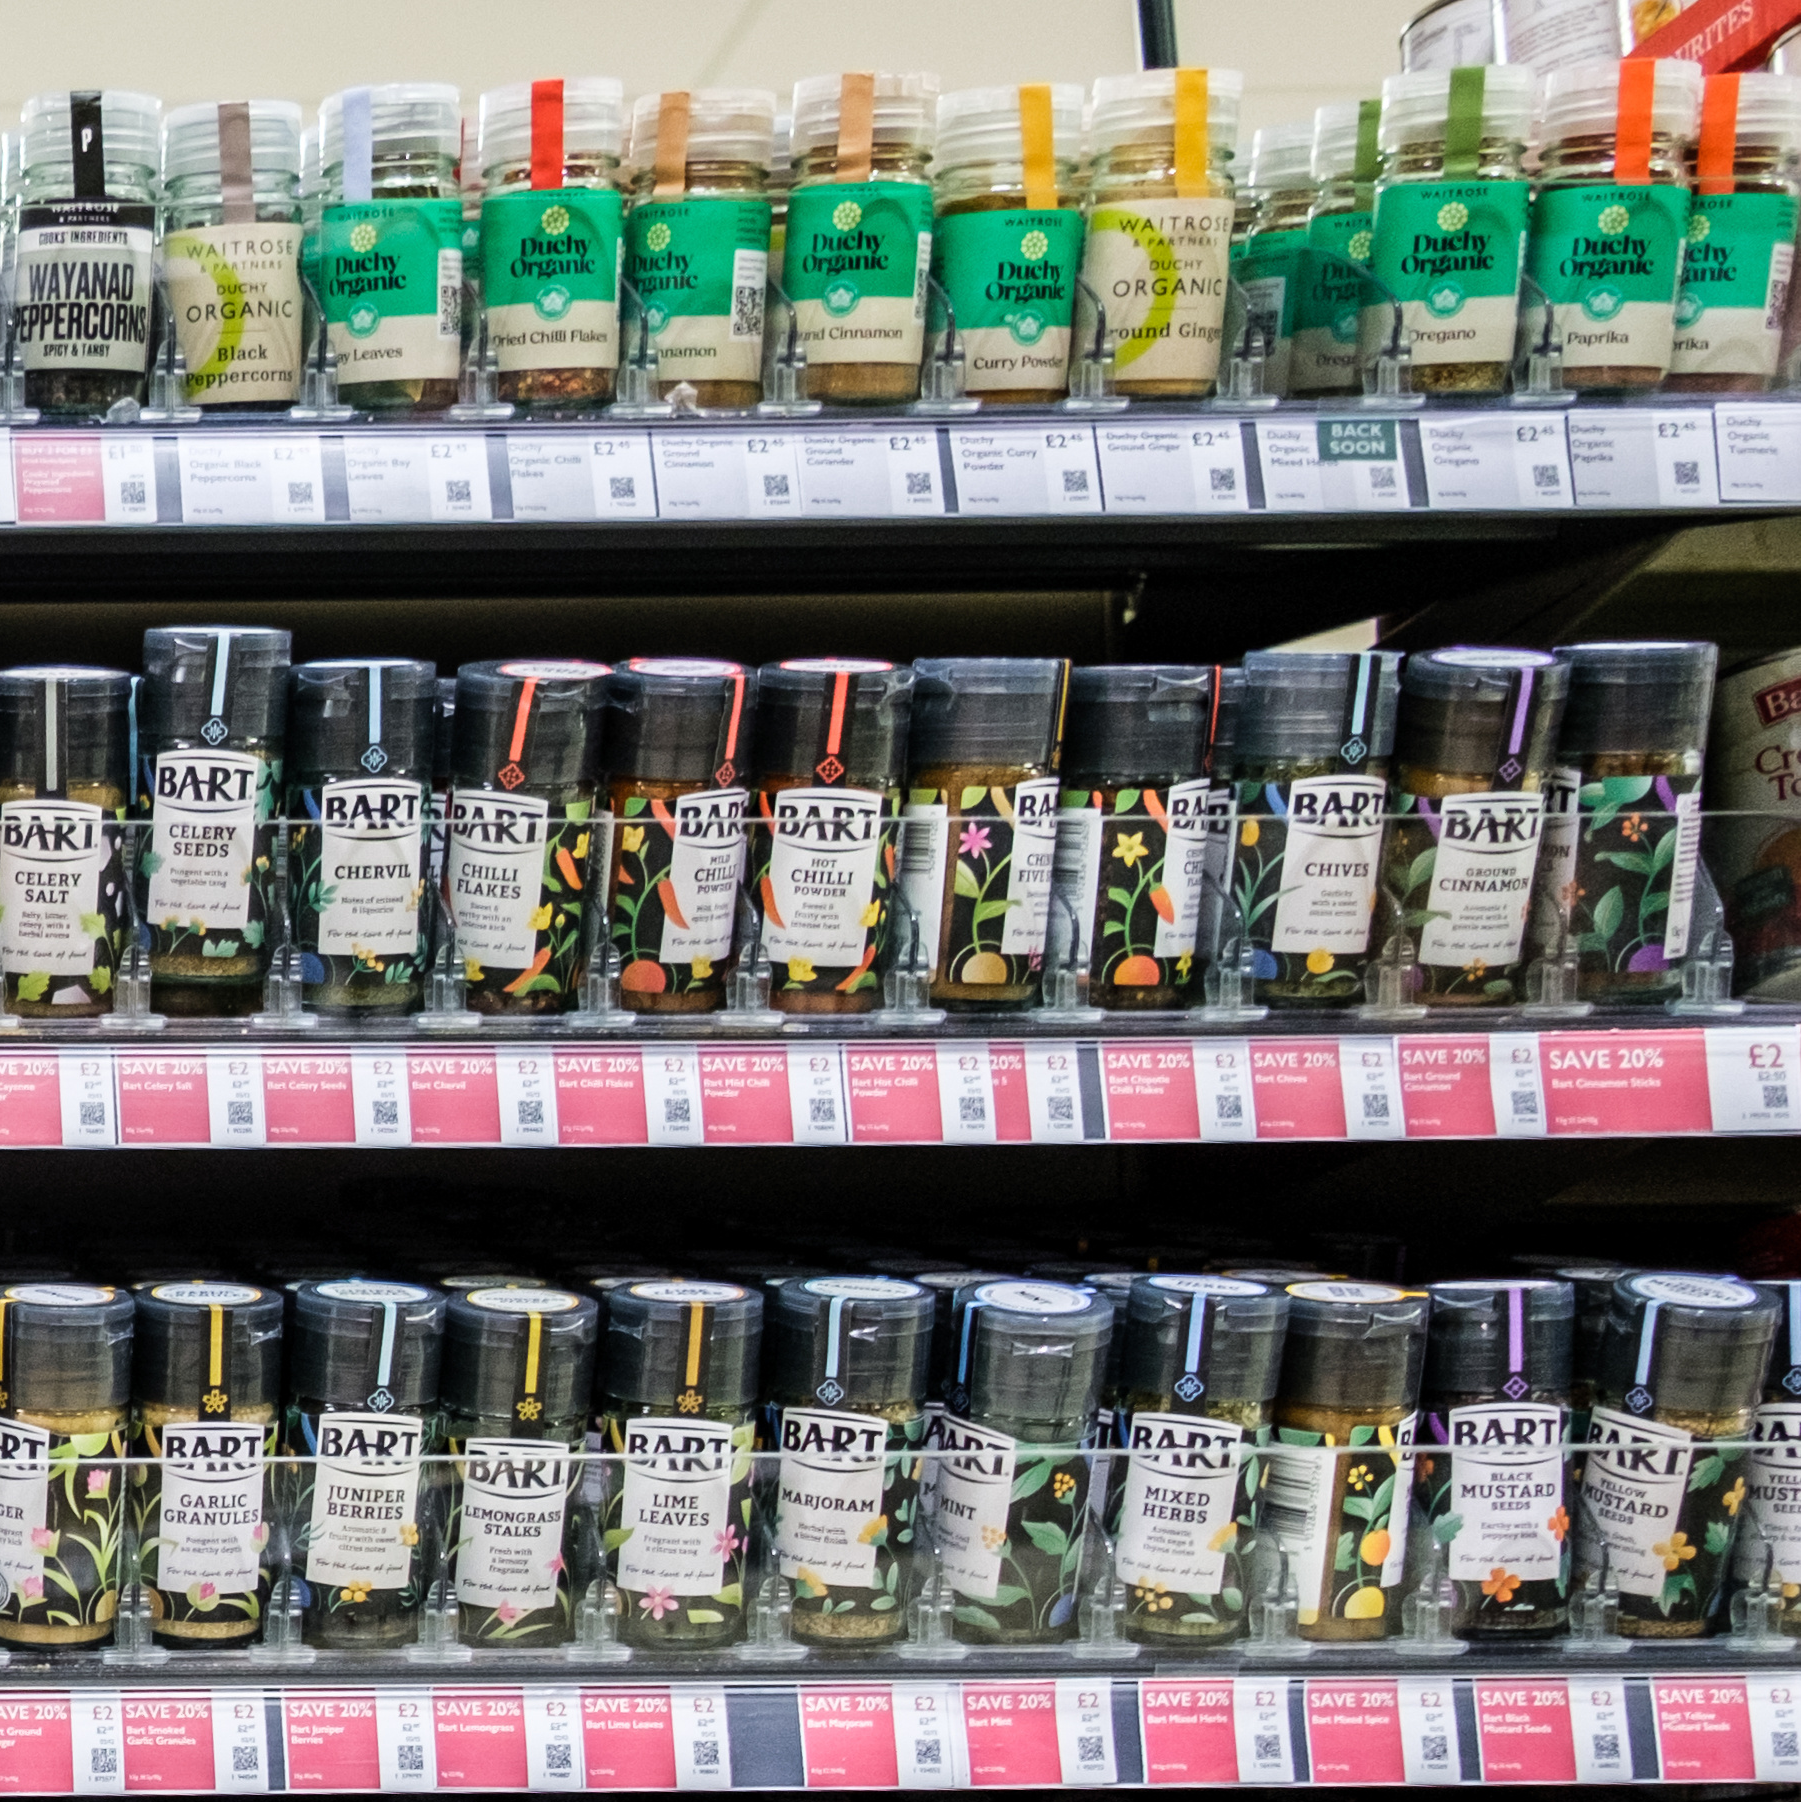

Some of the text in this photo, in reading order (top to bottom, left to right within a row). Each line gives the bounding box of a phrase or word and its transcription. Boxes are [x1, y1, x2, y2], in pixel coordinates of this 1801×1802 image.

[520, 235, 591, 261] Duchy
[510, 256, 595, 279] Organic
[30, 263, 133, 301] WAYANAD
[187, 300, 292, 323] ORGANIC
[1568, 332, 1629, 347] Paprika
[218, 346, 267, 362] Black
[187, 368, 293, 387] Peppercorns
[1332, 423, 1383, 438] BACK
[1330, 441, 1386, 456] SOON
[811, 859, 837, 868] HOT
[1305, 863, 1369, 878] CHIVES
[335, 864, 411, 880] CHERVIL
[791, 870, 853, 885] CHILLI
[794, 887, 846, 897] POWDER
[1439, 877, 1529, 893] CINNAMON
[1549, 1048, 1663, 1069] SAVE 20%
[1748, 1044, 1785, 1069] £2
[328, 1487, 405, 1503] JUNIPER
[1146, 1487, 1210, 1506] MIXED
[1461, 1483, 1555, 1499] MUSTARD
[180, 1494, 247, 1510] GARLIC
[654, 1495, 698, 1509] LIME
[782, 1490, 874, 1512] MARJORAM
[165, 1510, 259, 1526] GRANULES
[328, 1503, 403, 1521] BERRIES
[639, 1510, 709, 1527] LEAVES
[1142, 1506, 1207, 1523] HERBS
